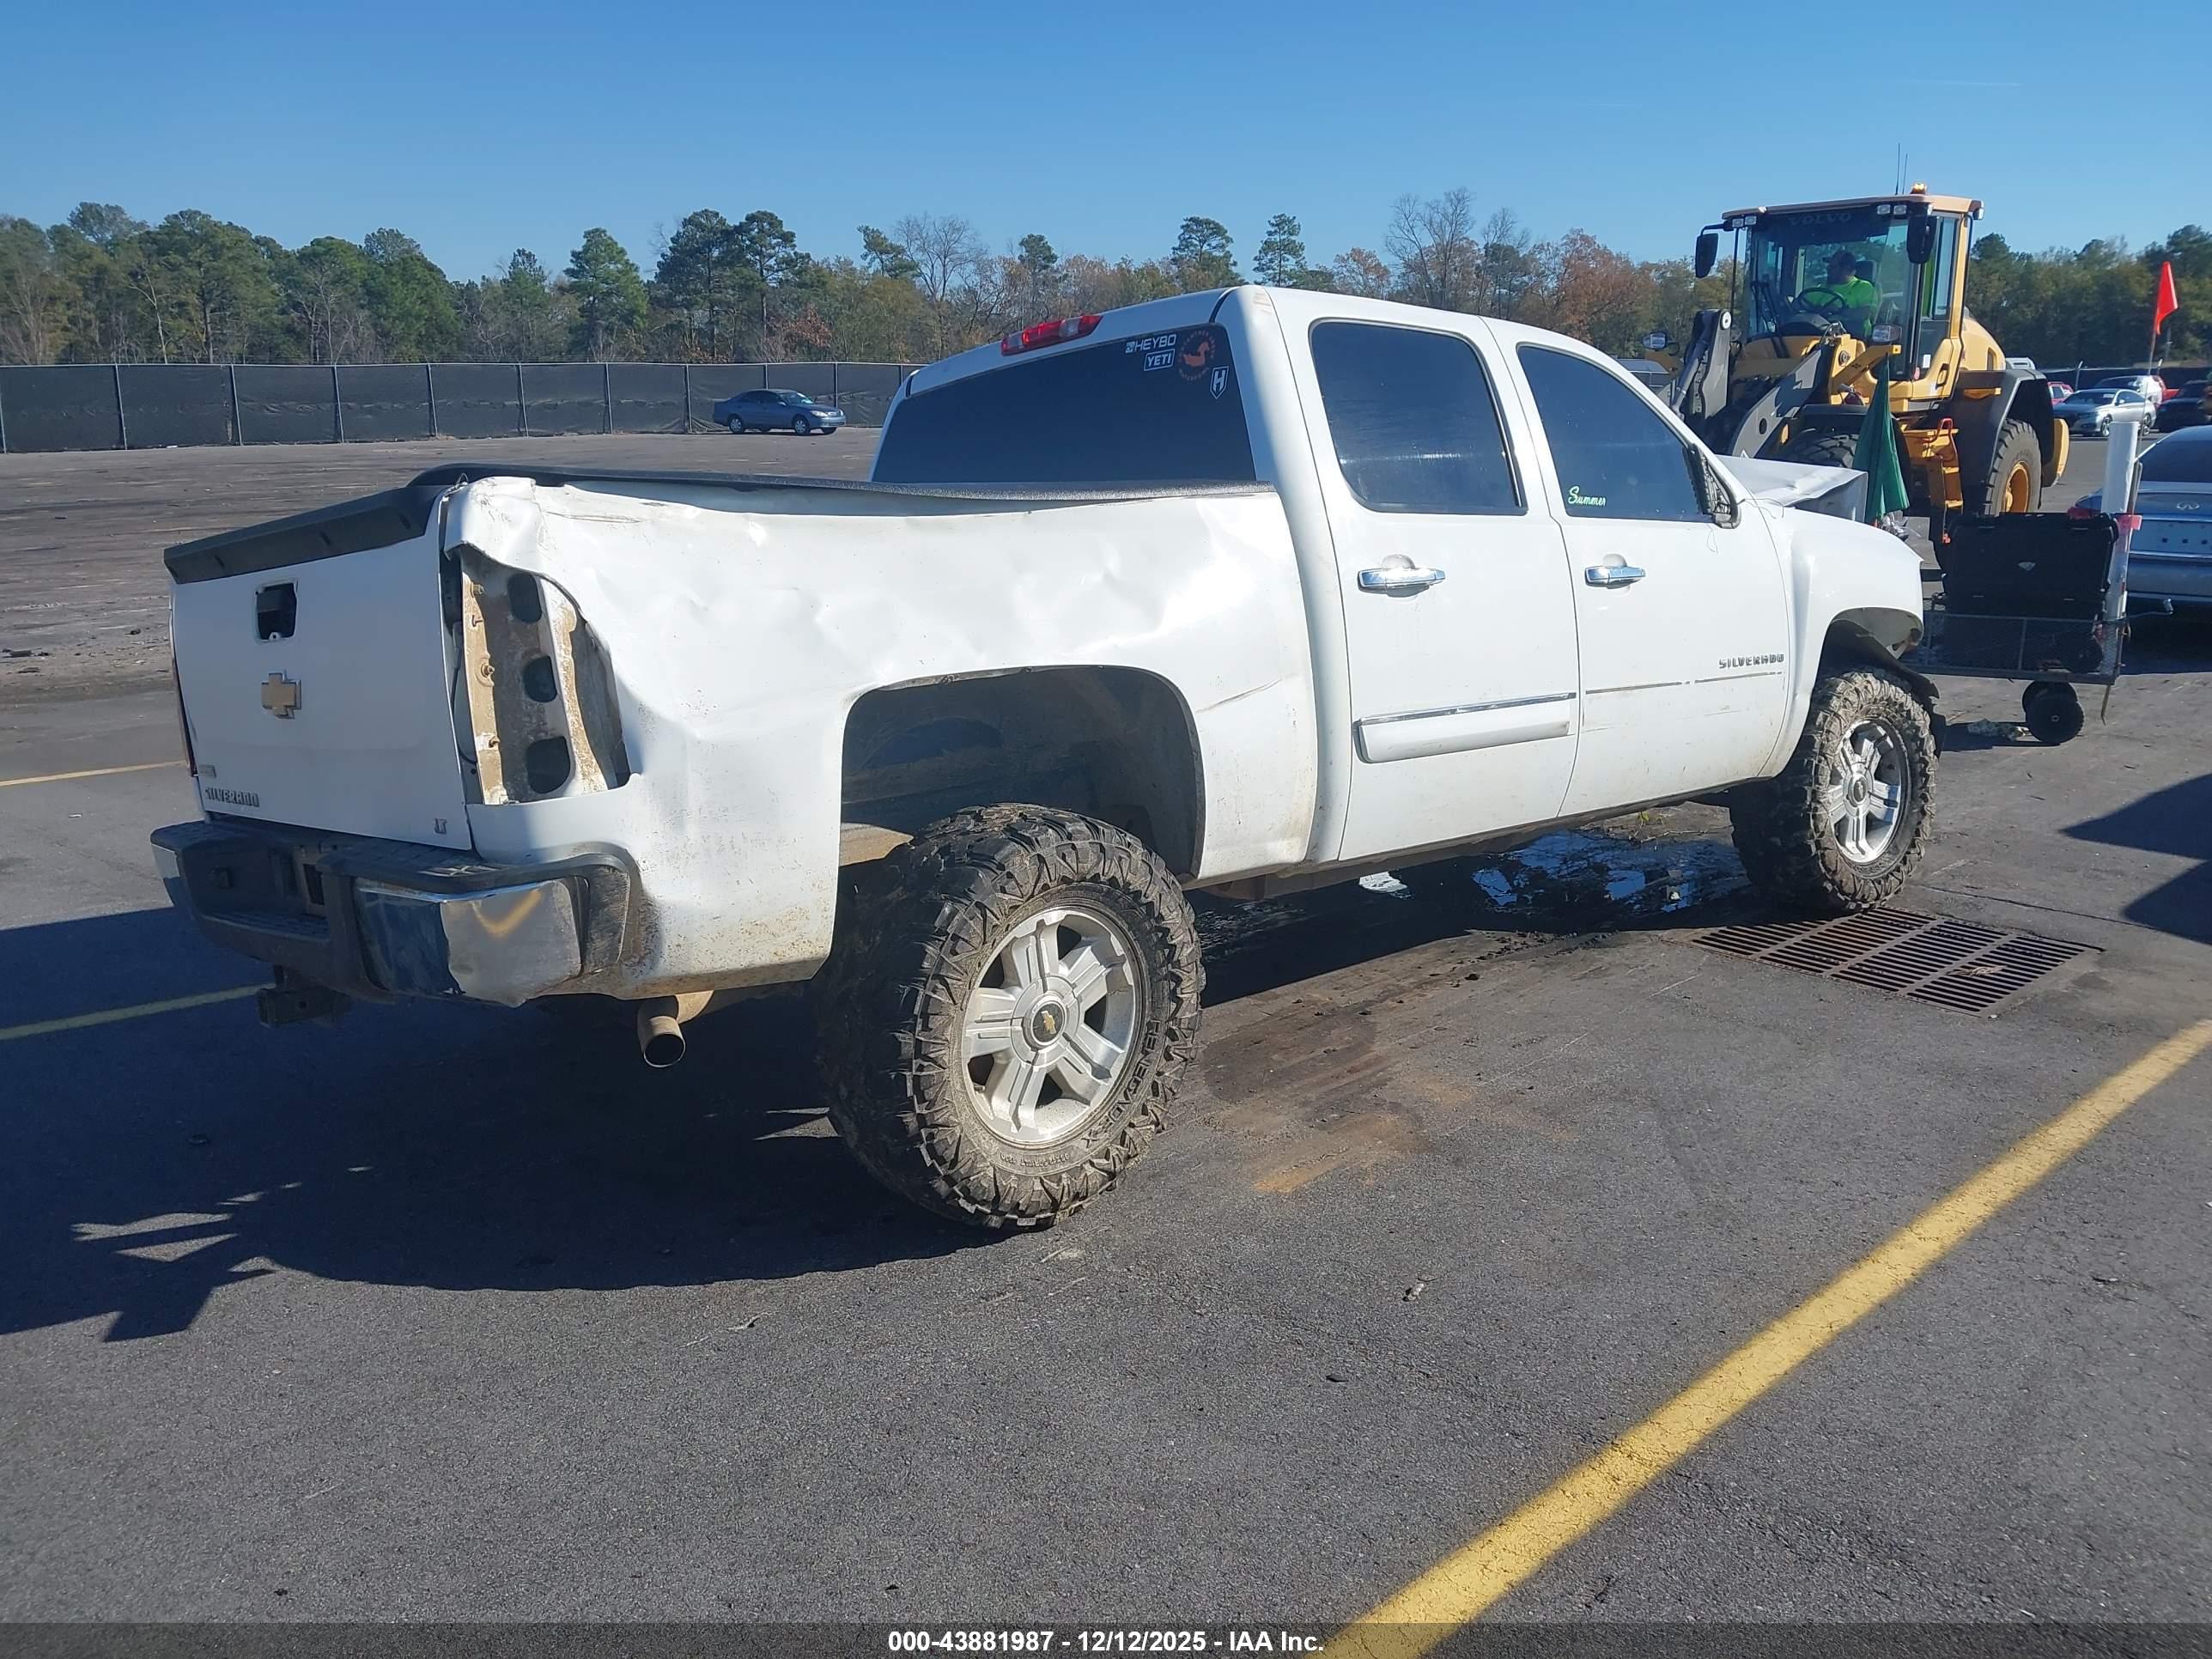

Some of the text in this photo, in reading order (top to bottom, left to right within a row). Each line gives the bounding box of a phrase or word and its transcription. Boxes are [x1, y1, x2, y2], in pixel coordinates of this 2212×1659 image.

[1787, 210, 1852, 227] VOLVO
[1134, 333, 1176, 352] HEYBO
[1146, 352, 1172, 368] YETI
[1567, 485, 1607, 507] Summer
[1718, 653, 1784, 669] SILVERADO
[204, 787, 260, 808] SILVERADO
